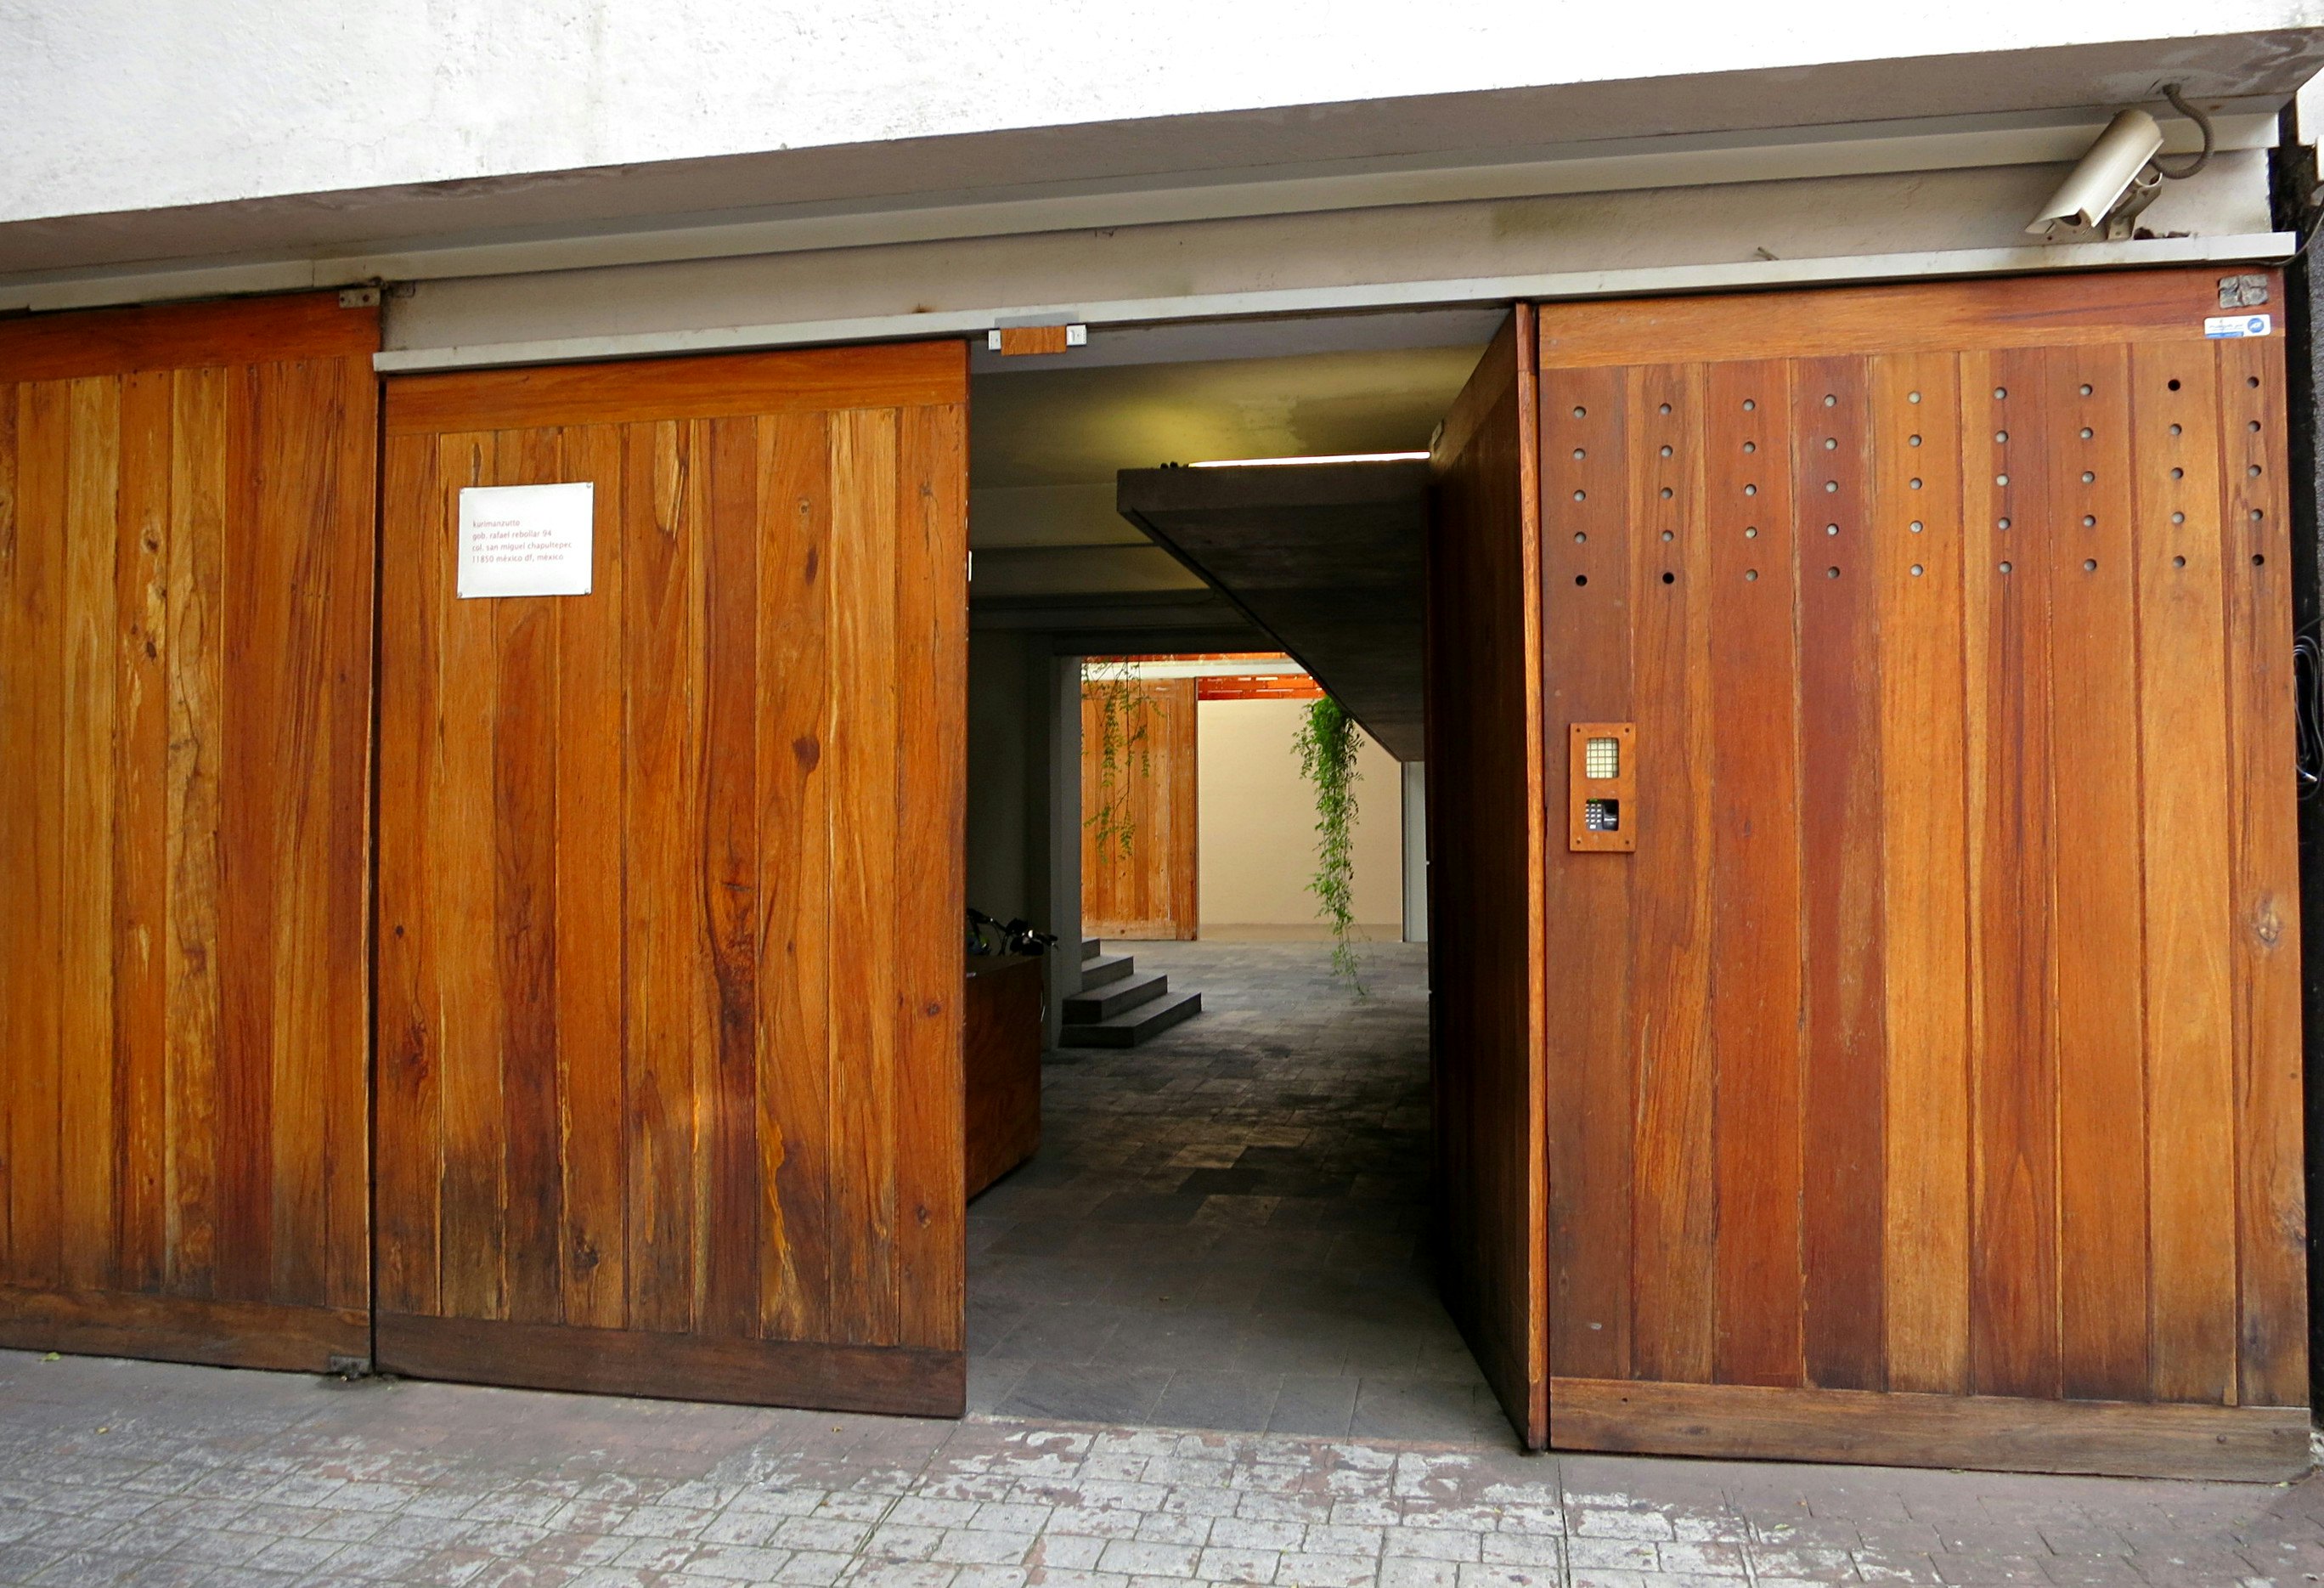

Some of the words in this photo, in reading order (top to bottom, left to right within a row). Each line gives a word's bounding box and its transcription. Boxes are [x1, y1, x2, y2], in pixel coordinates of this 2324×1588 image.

[472, 533, 488, 541] gob.
[500, 543, 525, 551] miguel
[527, 541, 572, 550] chapultepec
[525, 554, 534, 562] df,
